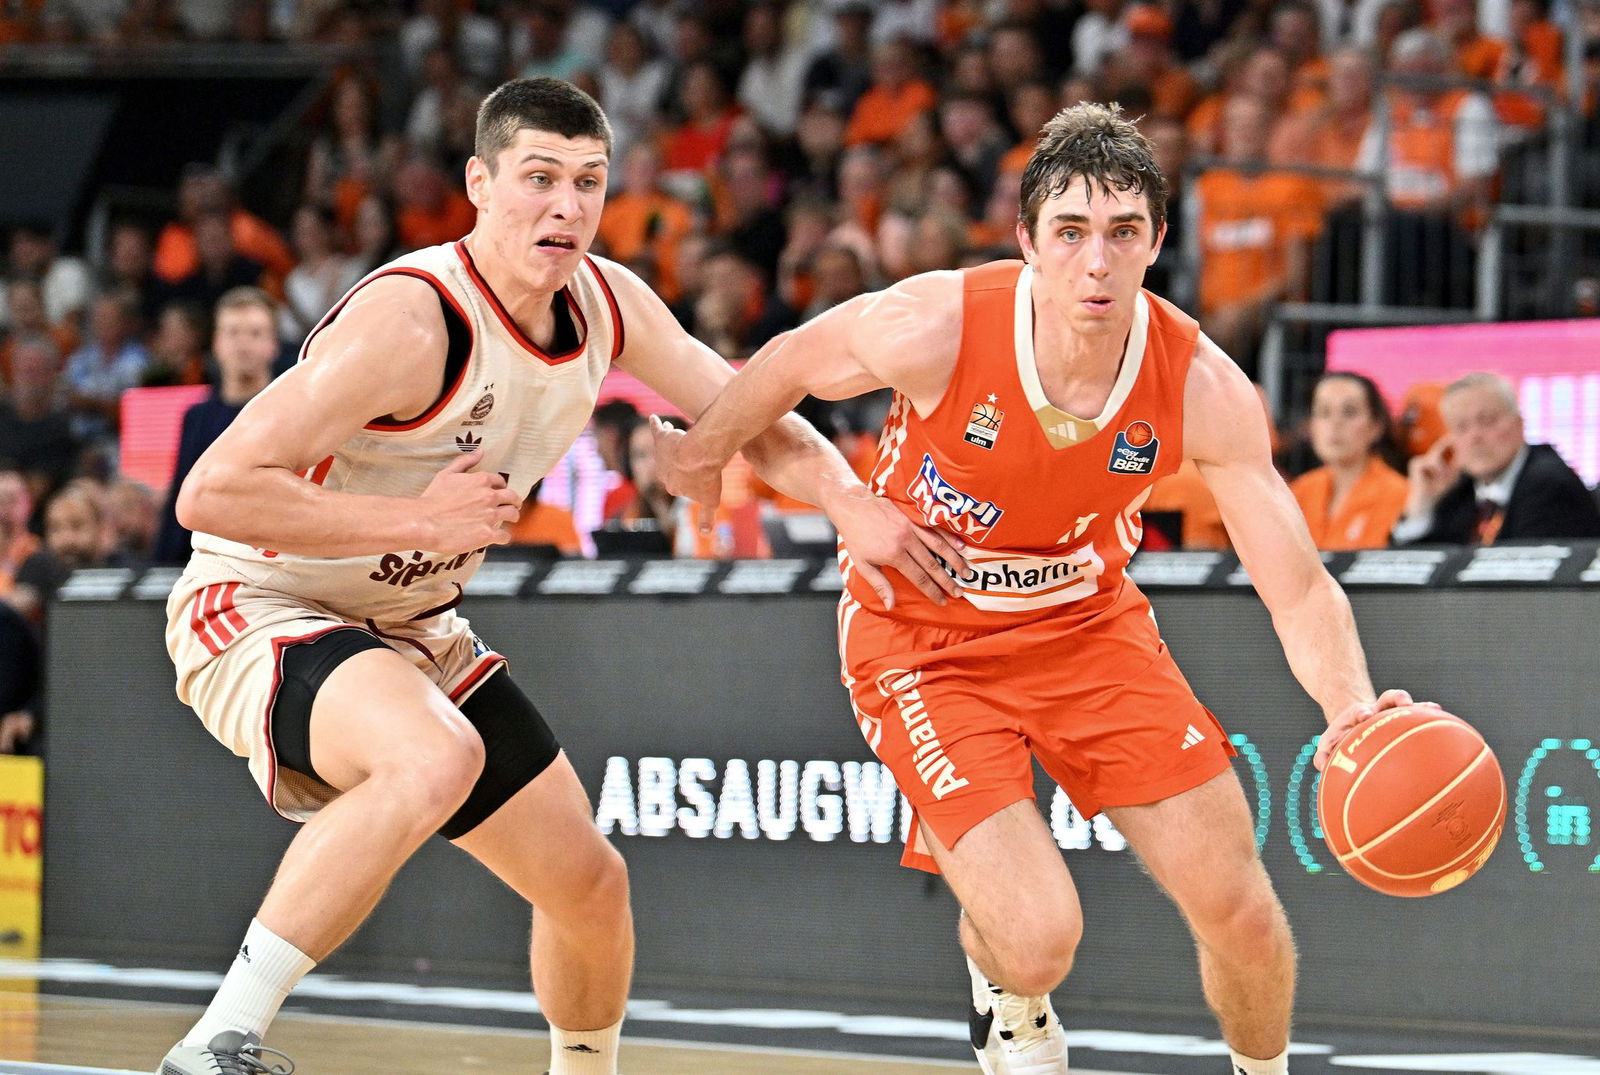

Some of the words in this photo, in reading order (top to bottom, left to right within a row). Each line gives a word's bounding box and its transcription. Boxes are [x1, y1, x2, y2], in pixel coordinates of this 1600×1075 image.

[970, 436, 987, 446] ulm
[1113, 458, 1147, 472] BBL
[924, 460, 998, 525] LIQUI
[893, 687, 971, 801] Allianz
[595, 755, 913, 844] ABSAUGW
